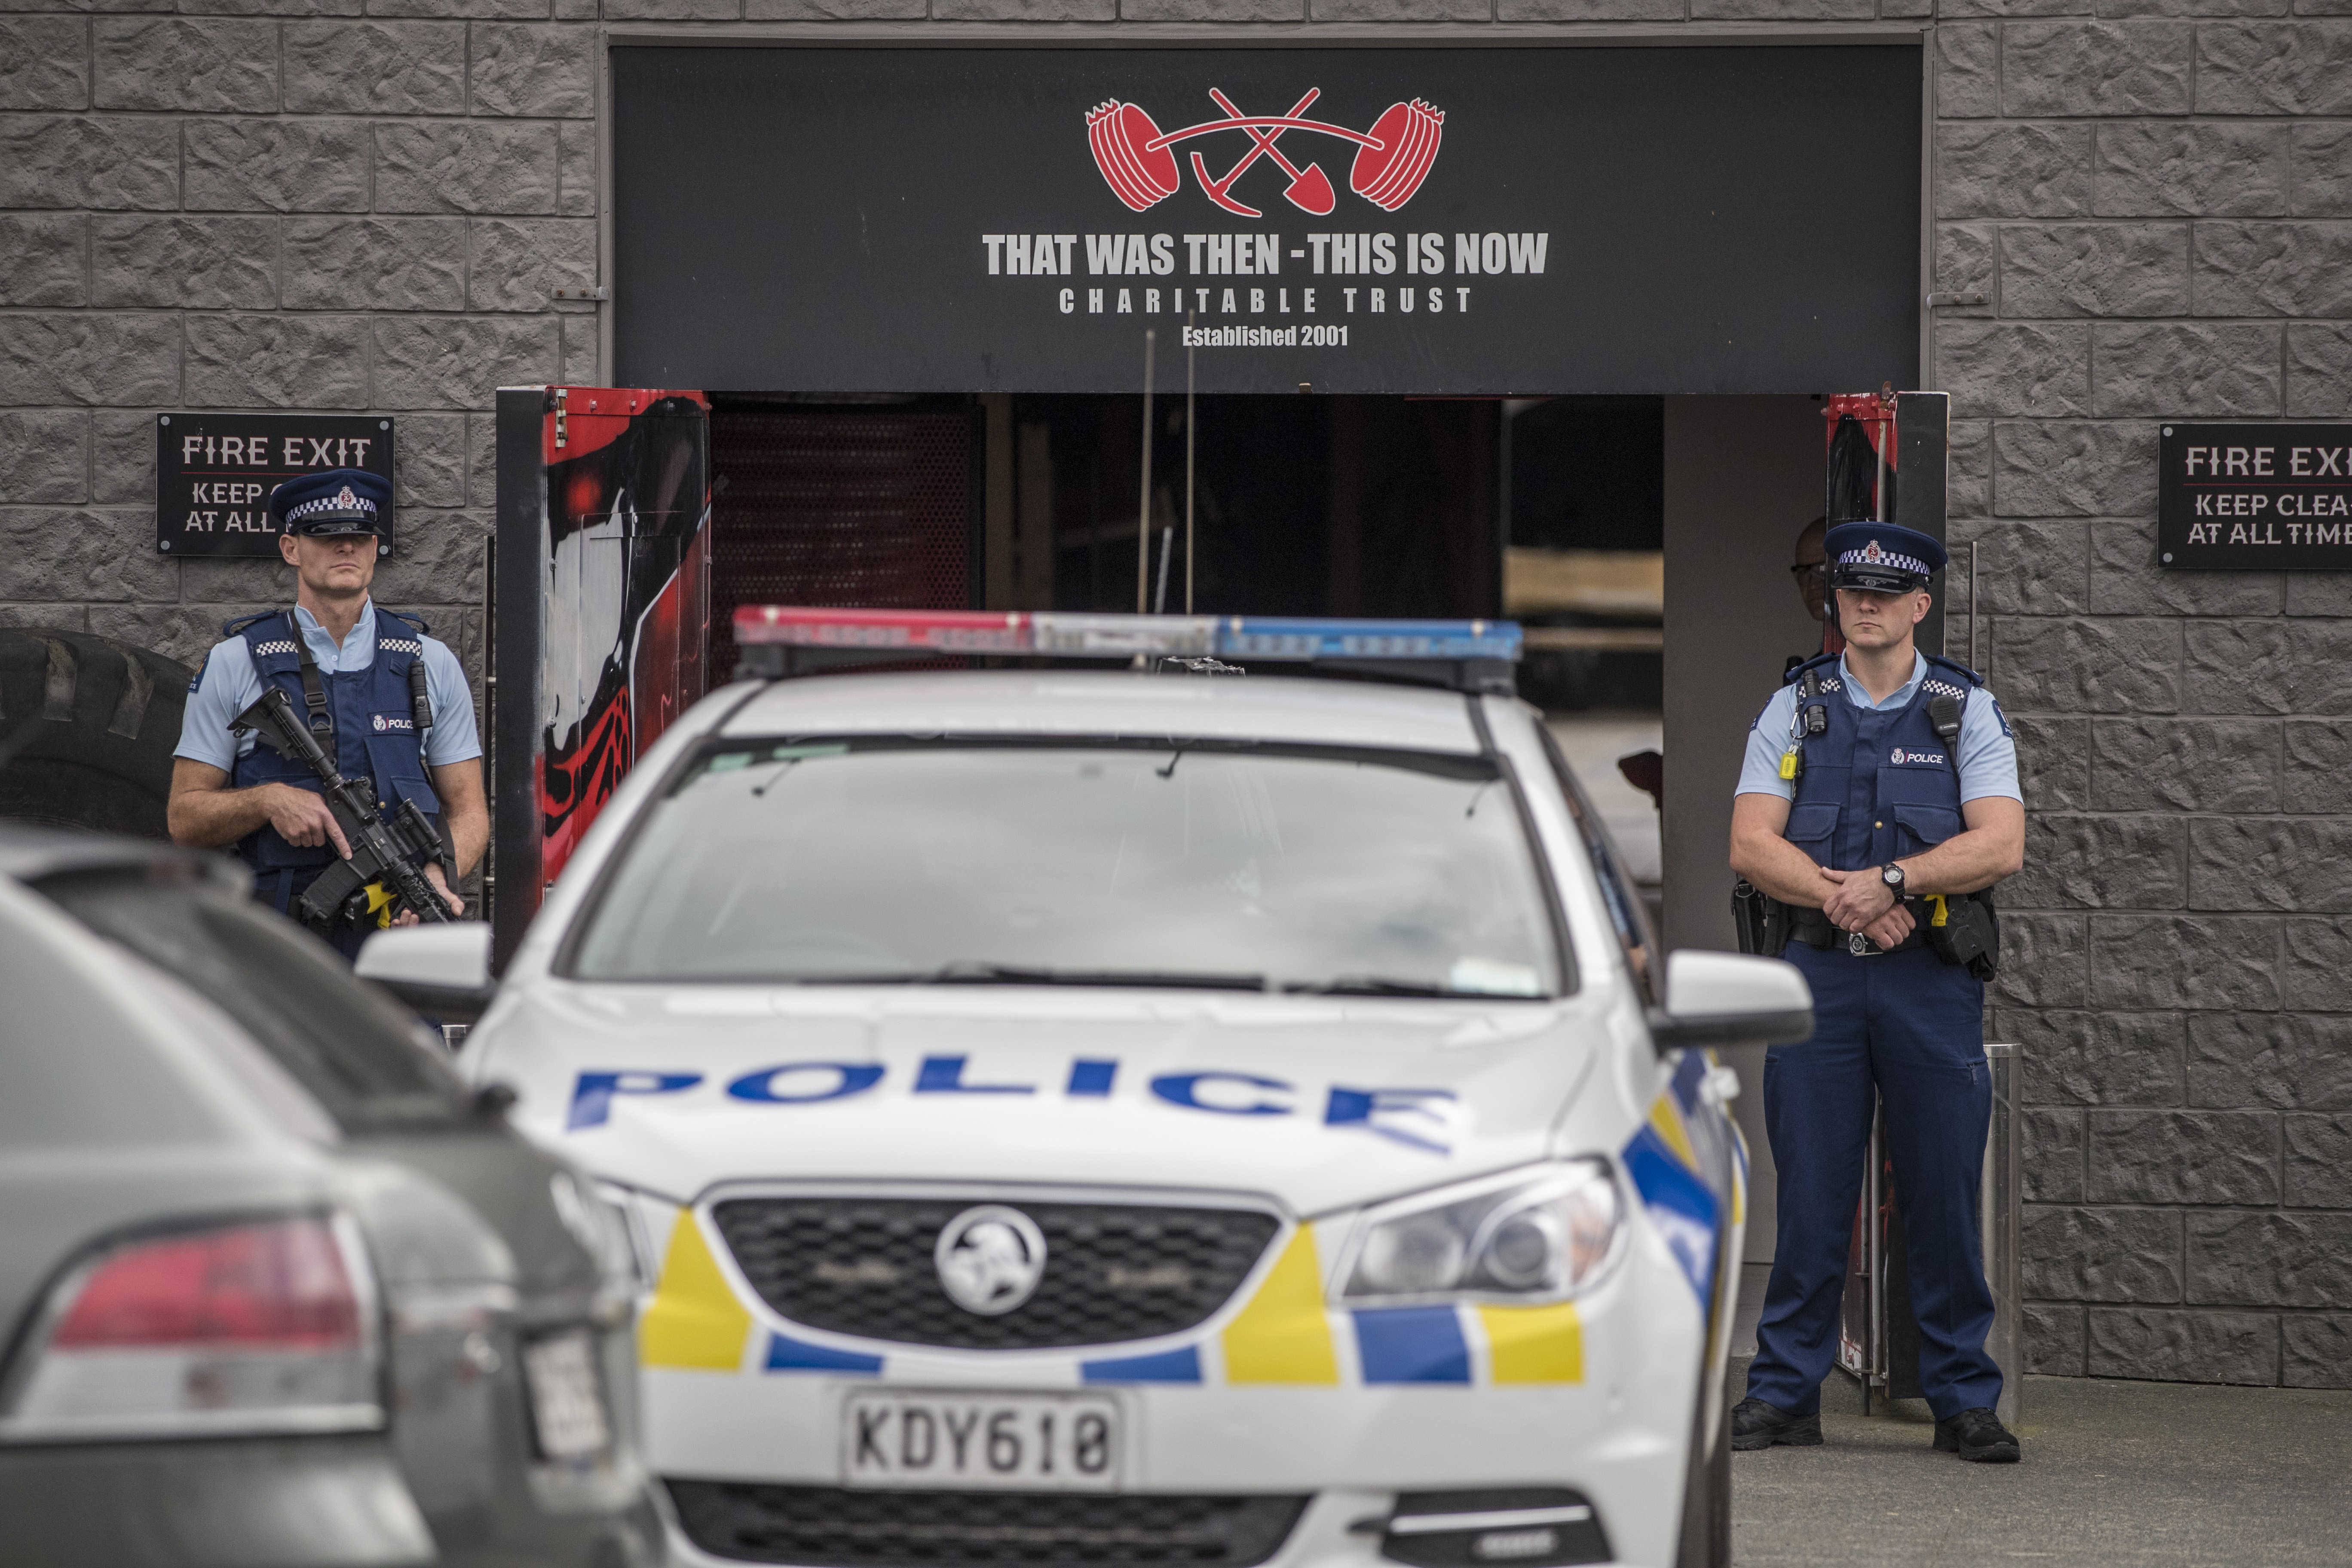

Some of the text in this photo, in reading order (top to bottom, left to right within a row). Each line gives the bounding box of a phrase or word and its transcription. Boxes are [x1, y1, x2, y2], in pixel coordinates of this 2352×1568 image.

[983, 235, 1077, 275] THAT
[1085, 234, 1175, 275] WAS
[1183, 234, 1280, 275] THEN
[1407, 233, 1445, 275] IS
[1455, 233, 1549, 275] NOW
[1060, 288, 1470, 314] CHARITABLE TRUST
[1183, 325, 1348, 347] Established 2001
[181, 436, 371, 467] FIRE EXIT
[2185, 447, 2275, 476] FIRE
[192, 483, 263, 504] KEEP
[2196, 494, 2352, 516] KEEP CLEA
[185, 511, 218, 532] AT
[225, 511, 276, 533] ALL
[2187, 523, 2222, 545] AT
[2229, 523, 2282, 545] ALL
[1907, 753, 1944, 764] POLICE
[566, 1054, 1458, 1155] POLICE
[857, 1408, 1109, 1473] KDY610
